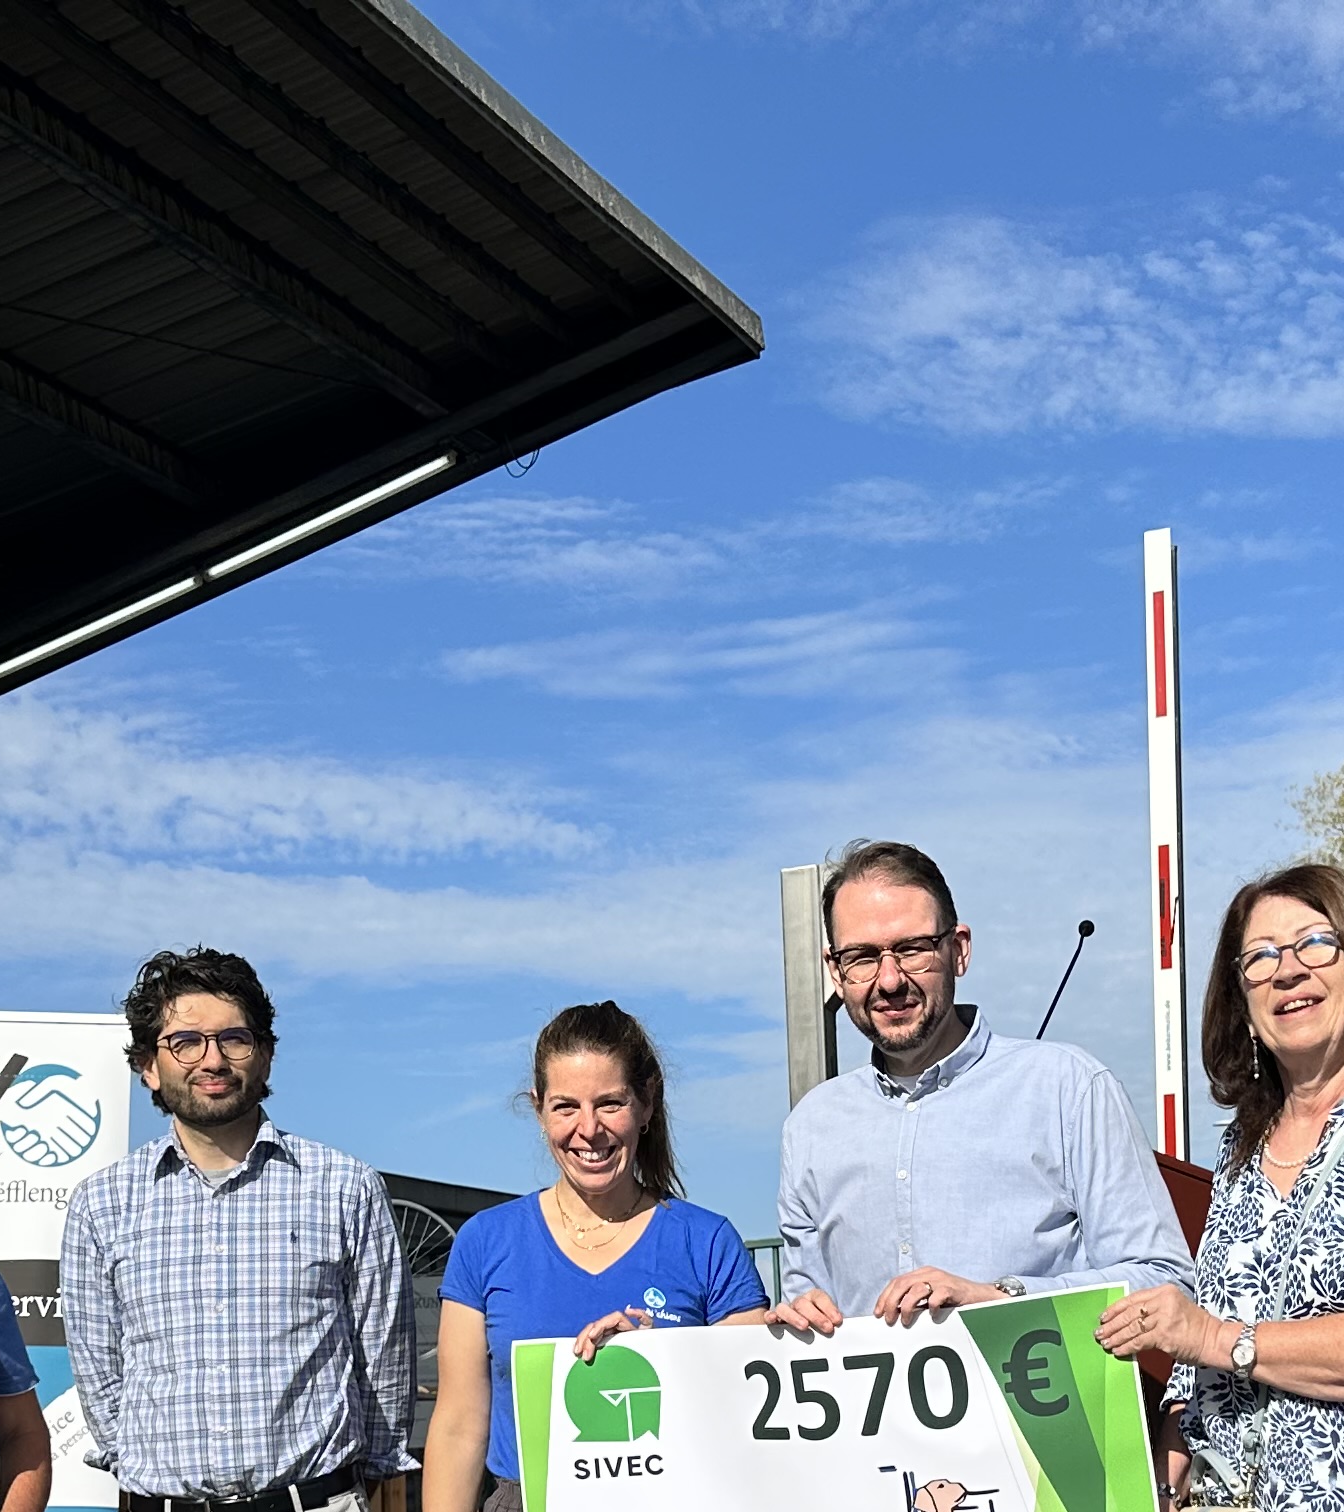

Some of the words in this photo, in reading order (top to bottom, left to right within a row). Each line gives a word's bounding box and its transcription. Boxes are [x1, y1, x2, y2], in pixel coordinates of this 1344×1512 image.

[744, 1345, 969, 1442] 2570
[1001, 1329, 1070, 1418] €
[573, 1453, 665, 1480] SIVEC
